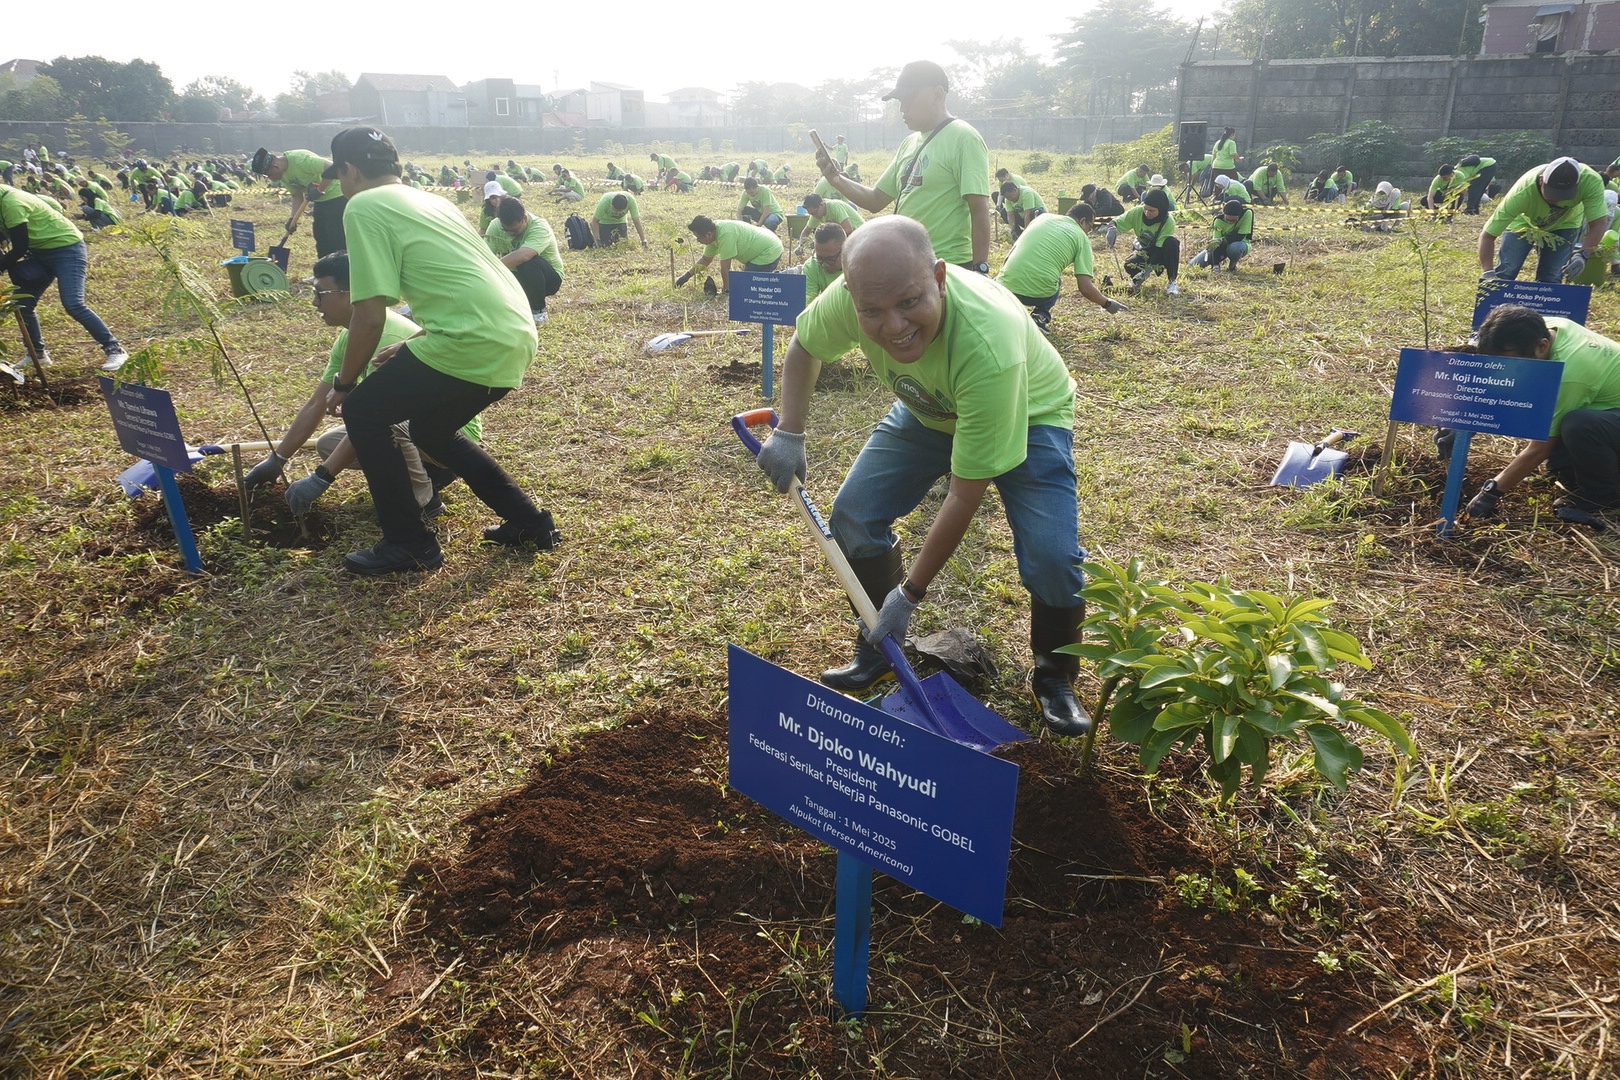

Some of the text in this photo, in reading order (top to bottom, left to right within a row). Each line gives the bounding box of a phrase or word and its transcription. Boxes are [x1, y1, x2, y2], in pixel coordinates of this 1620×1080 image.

[1435, 371, 1515, 387] Mr. Koji Inokuchi
[1449, 357, 1505, 370] Ditanam oleh:
[1421, 390, 1452, 399] Panasonic
[1454, 393, 1473, 402] Gobel
[1474, 395, 1498, 405] Energy
[1499, 398, 1533, 409] Indonesia
[1457, 385, 1486, 394] Director
[1440, 408, 1459, 418] Tanggal
[1473, 419, 1500, 429] Chinensis)
[801, 490, 832, 536] CARMEN
[806, 693, 906, 748] Ditanam oleh:
[779, 712, 937, 799] Mr. Djoko Wahyudi
[826, 757, 878, 792] President
[749, 733, 975, 853] Federasi Serikat Pekerja Panasonic GOBEL
[789, 804, 914, 876] Alpukat (Persea Americana)
[804, 795, 837, 821] Tanggal
[844, 817, 849, 826] 1
[851, 820, 870, 838] Mei
[873, 830, 897, 850] 2025
